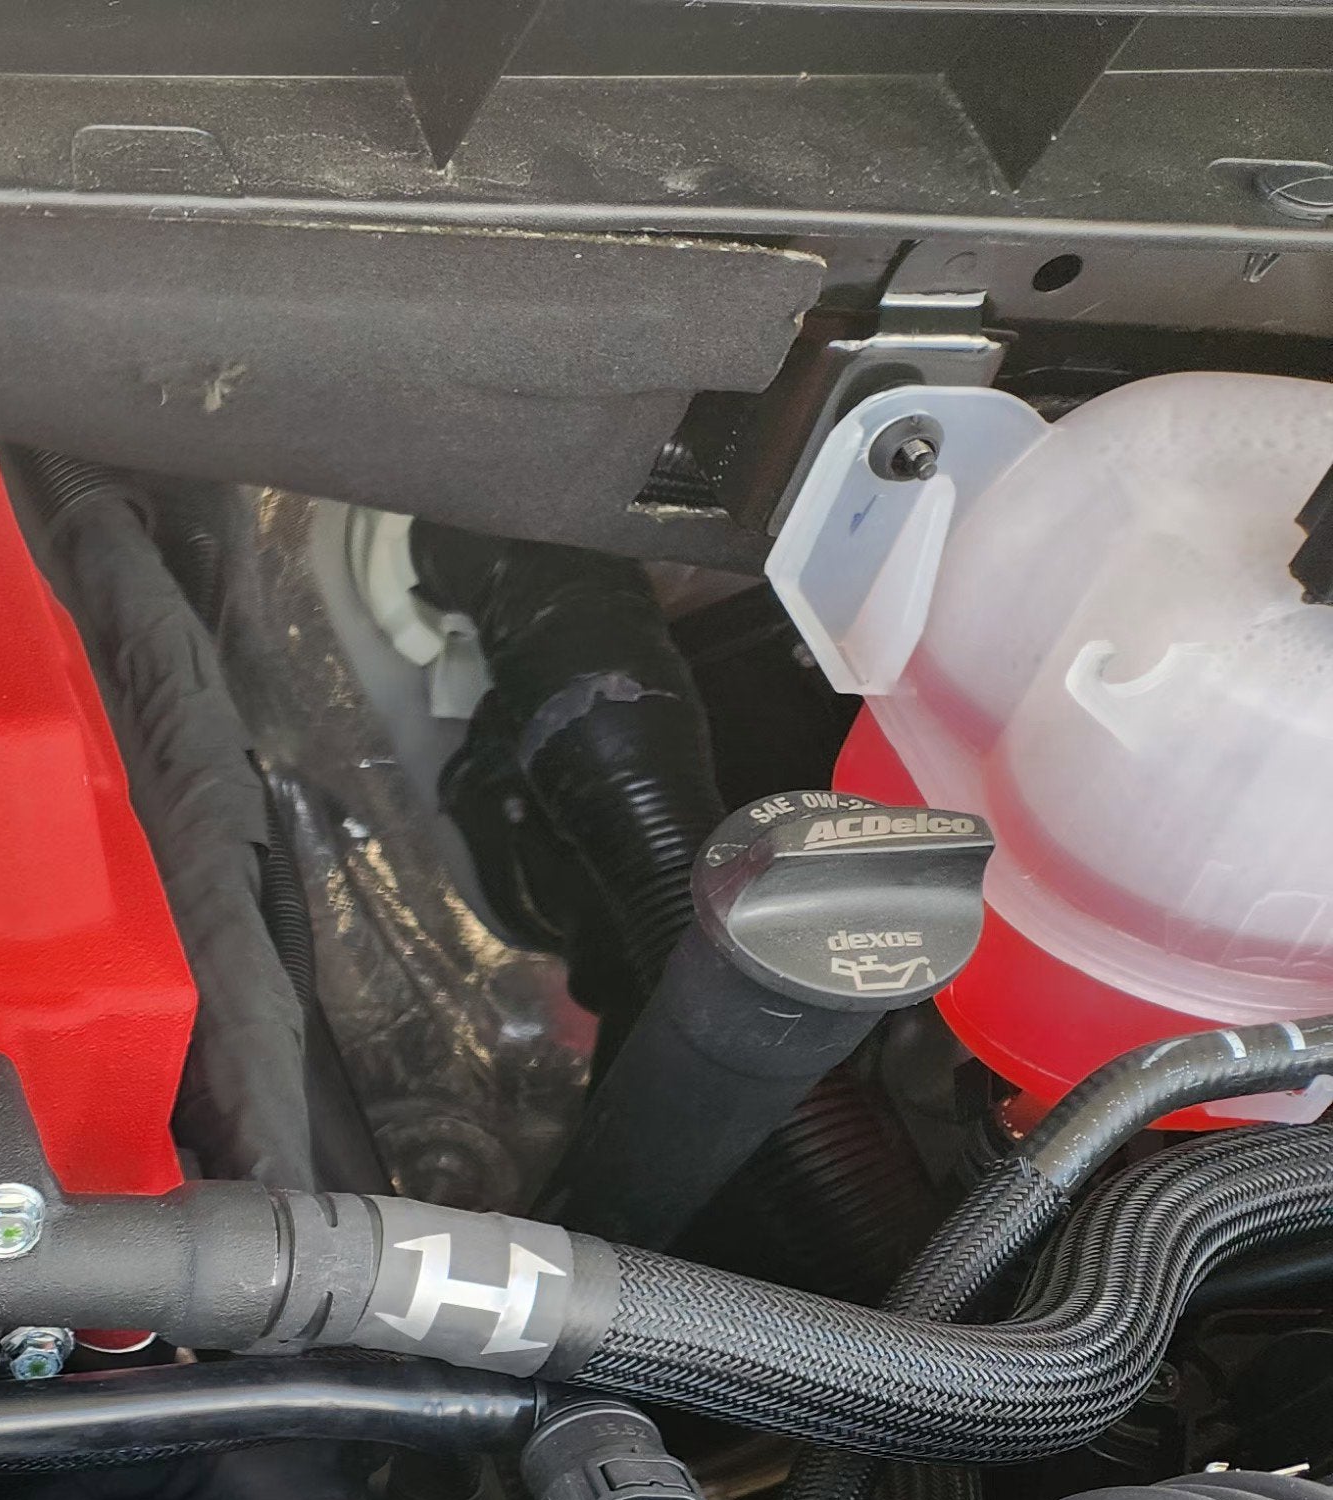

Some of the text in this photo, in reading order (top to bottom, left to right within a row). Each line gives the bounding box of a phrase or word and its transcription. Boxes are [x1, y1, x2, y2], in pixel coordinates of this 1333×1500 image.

[748, 795, 796, 825] SAE
[803, 814, 977, 841] ACDelco
[826, 928, 925, 951] dexos
